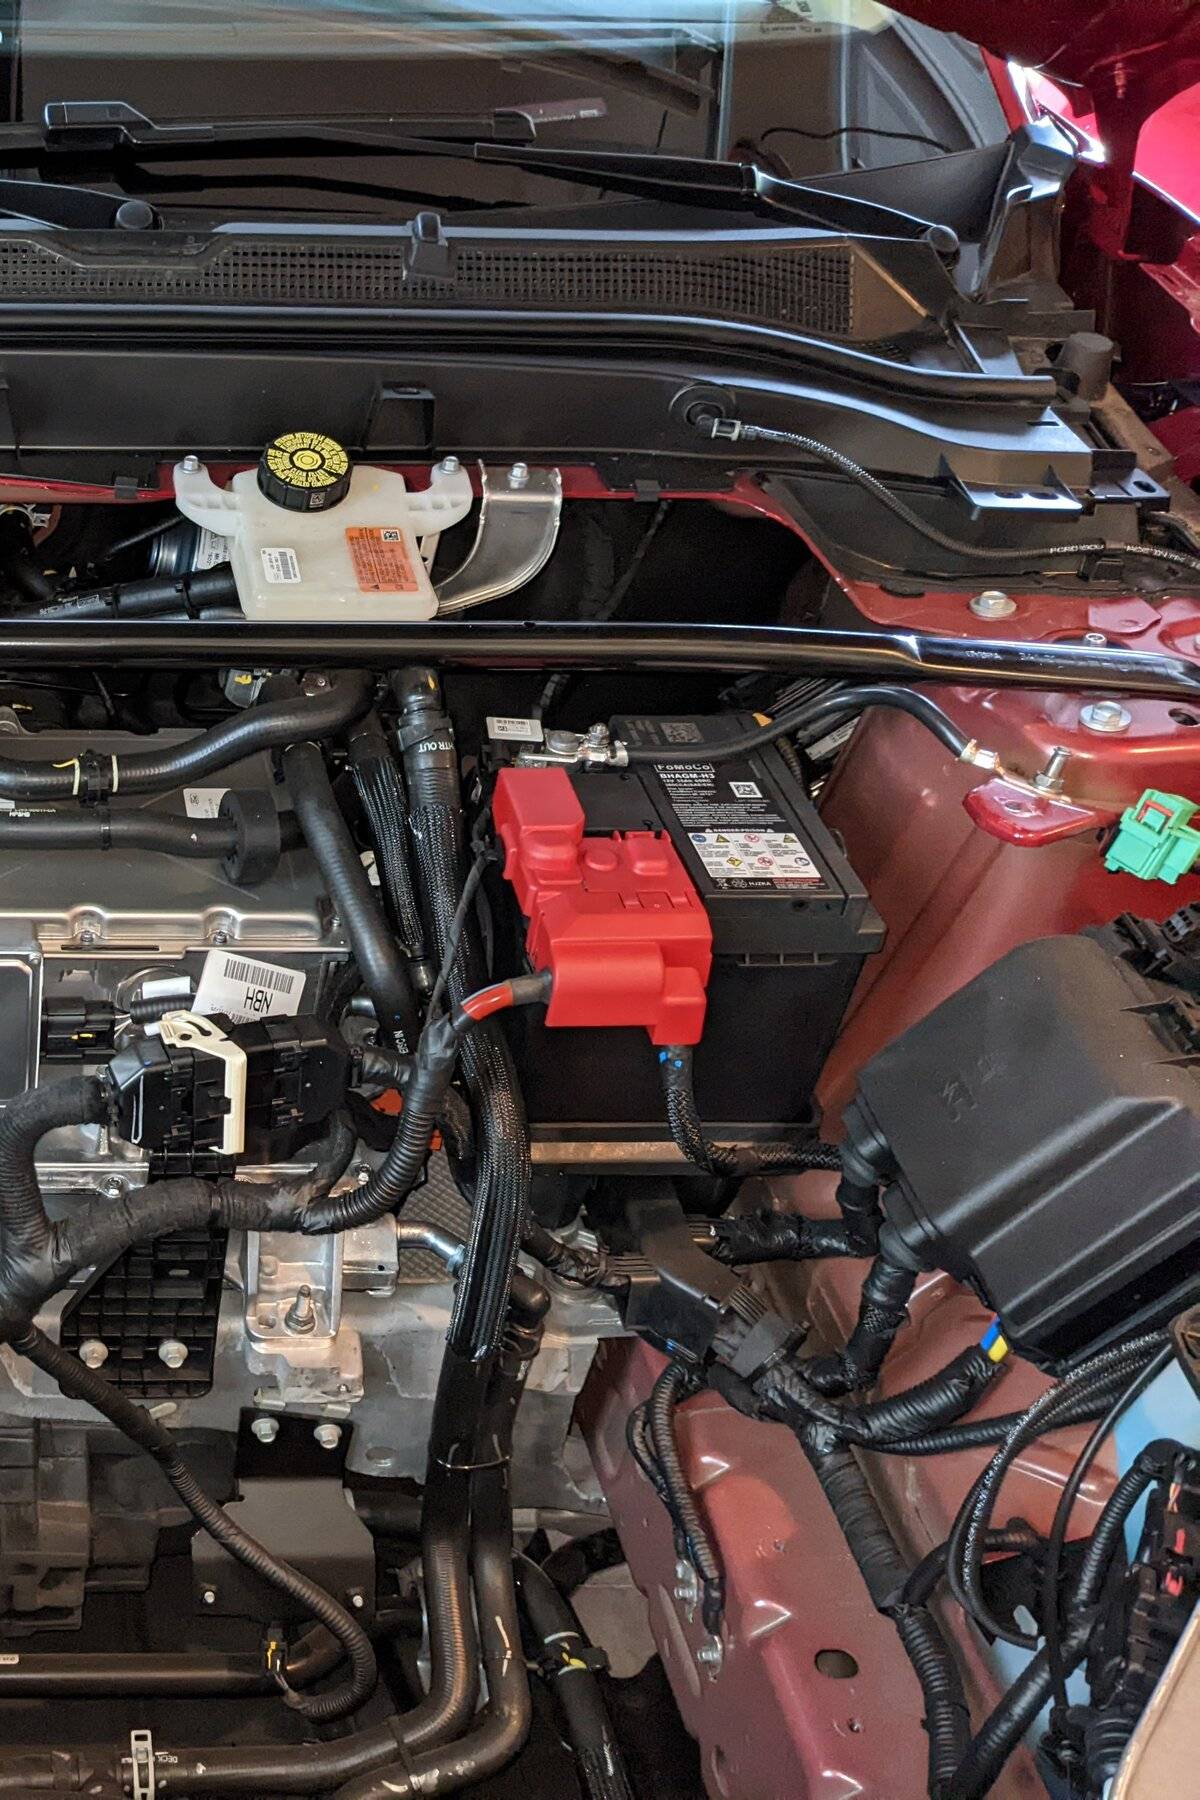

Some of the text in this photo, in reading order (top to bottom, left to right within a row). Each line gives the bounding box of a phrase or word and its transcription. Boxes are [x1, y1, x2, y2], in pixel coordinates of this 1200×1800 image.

[419, 741, 437, 753] OUT
[244, 987, 273, 1014] NBH
[157, 1755, 178, 1764] DECK
